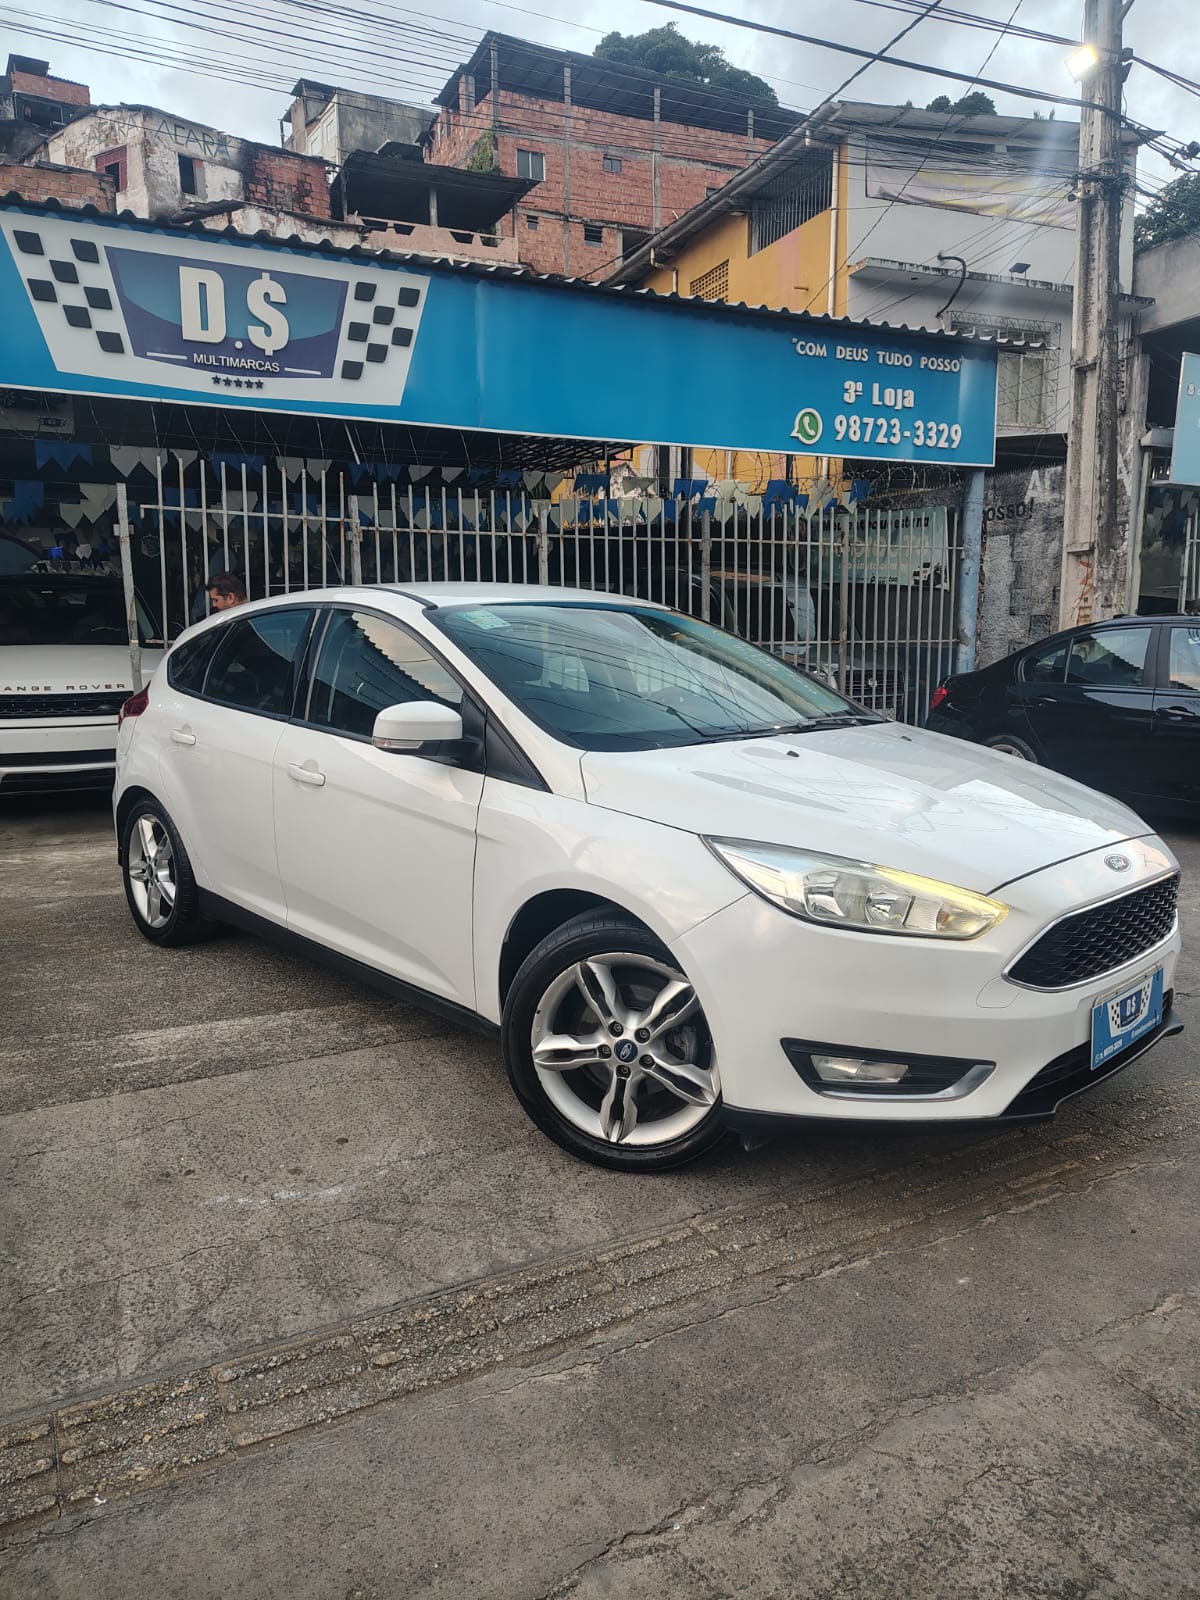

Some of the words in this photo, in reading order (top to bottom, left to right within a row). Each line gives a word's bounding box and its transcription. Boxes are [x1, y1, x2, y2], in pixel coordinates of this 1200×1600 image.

[193, 353, 281, 373] MULTIMARCAS
[836, 346, 869, 362] DEUS
[876, 351, 913, 367] TUDO
[872, 382, 915, 410] Loja
[834, 414, 962, 448] 98723-3329
